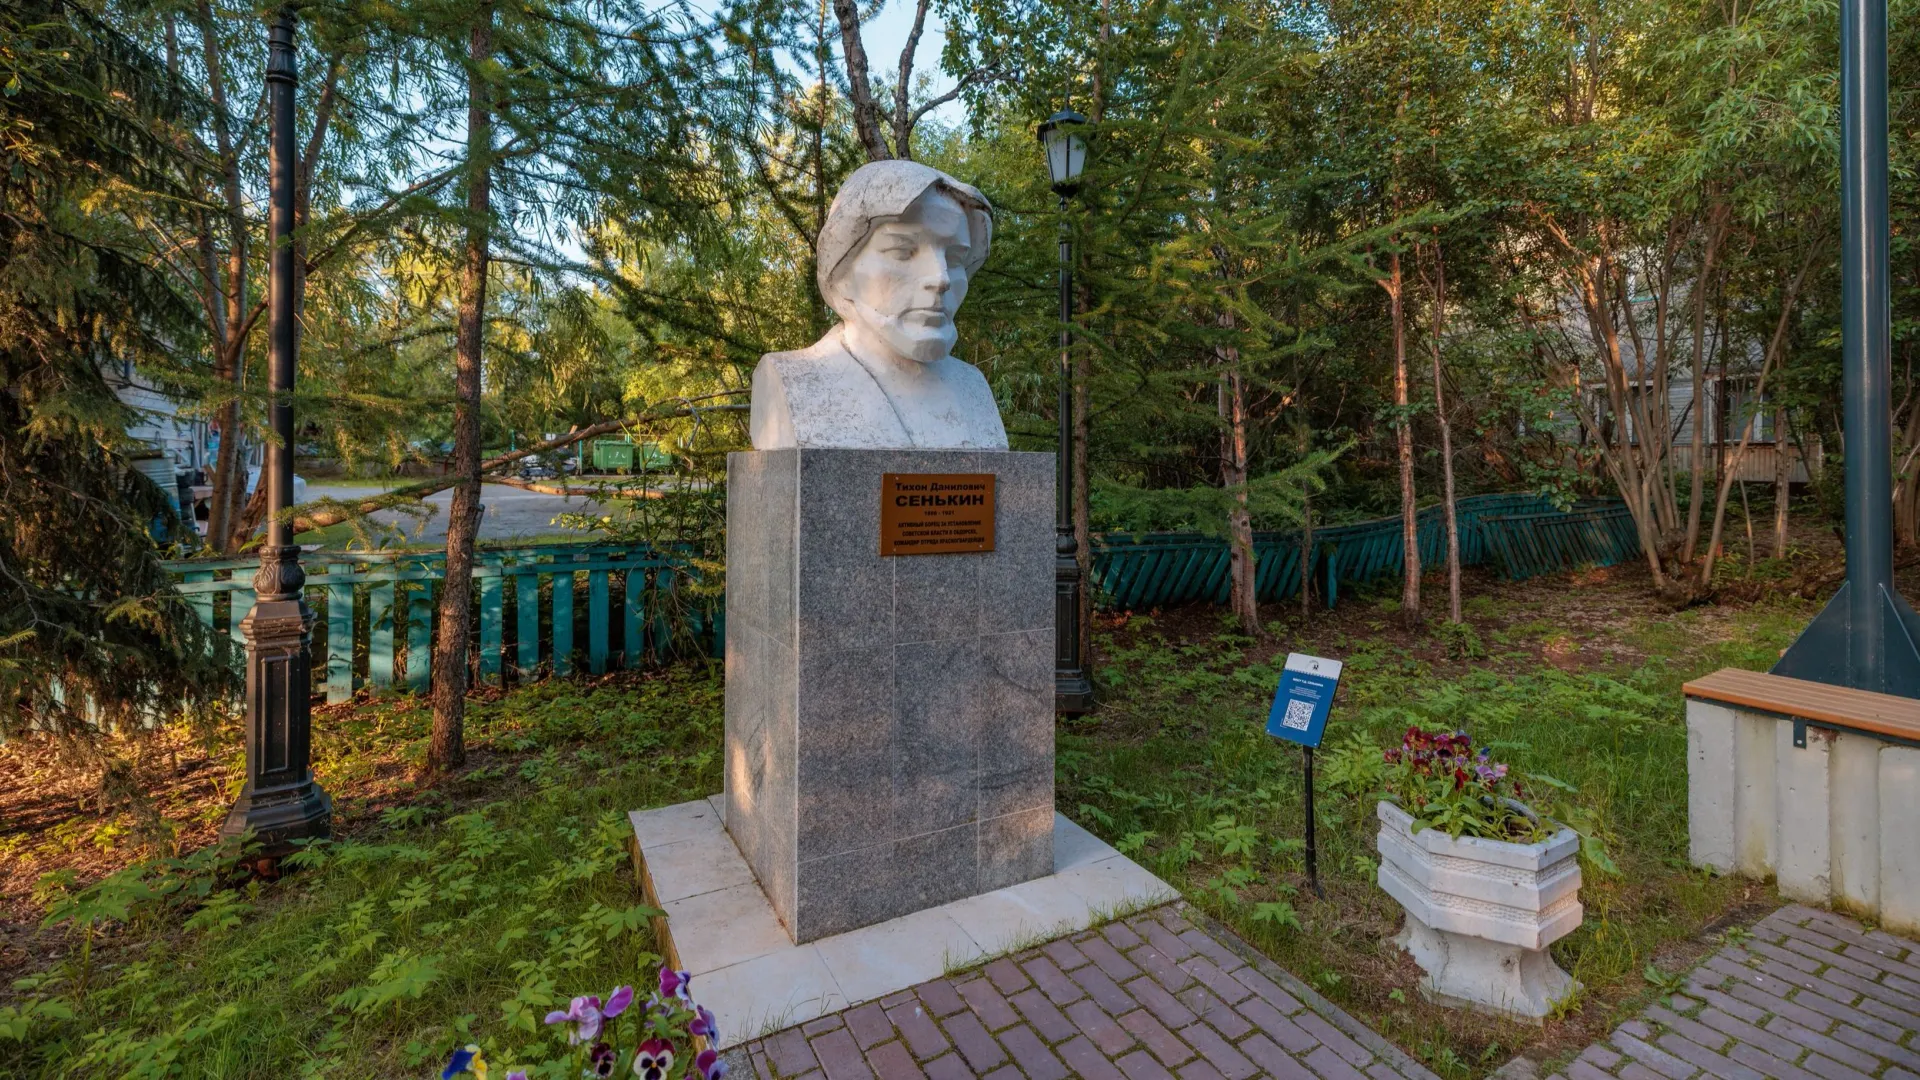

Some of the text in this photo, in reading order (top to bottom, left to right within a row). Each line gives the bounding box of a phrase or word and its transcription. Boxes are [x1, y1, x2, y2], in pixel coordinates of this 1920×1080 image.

[895, 483, 985, 492] Тихон Данилович
[896, 495, 984, 506] СЕНЬКИН
